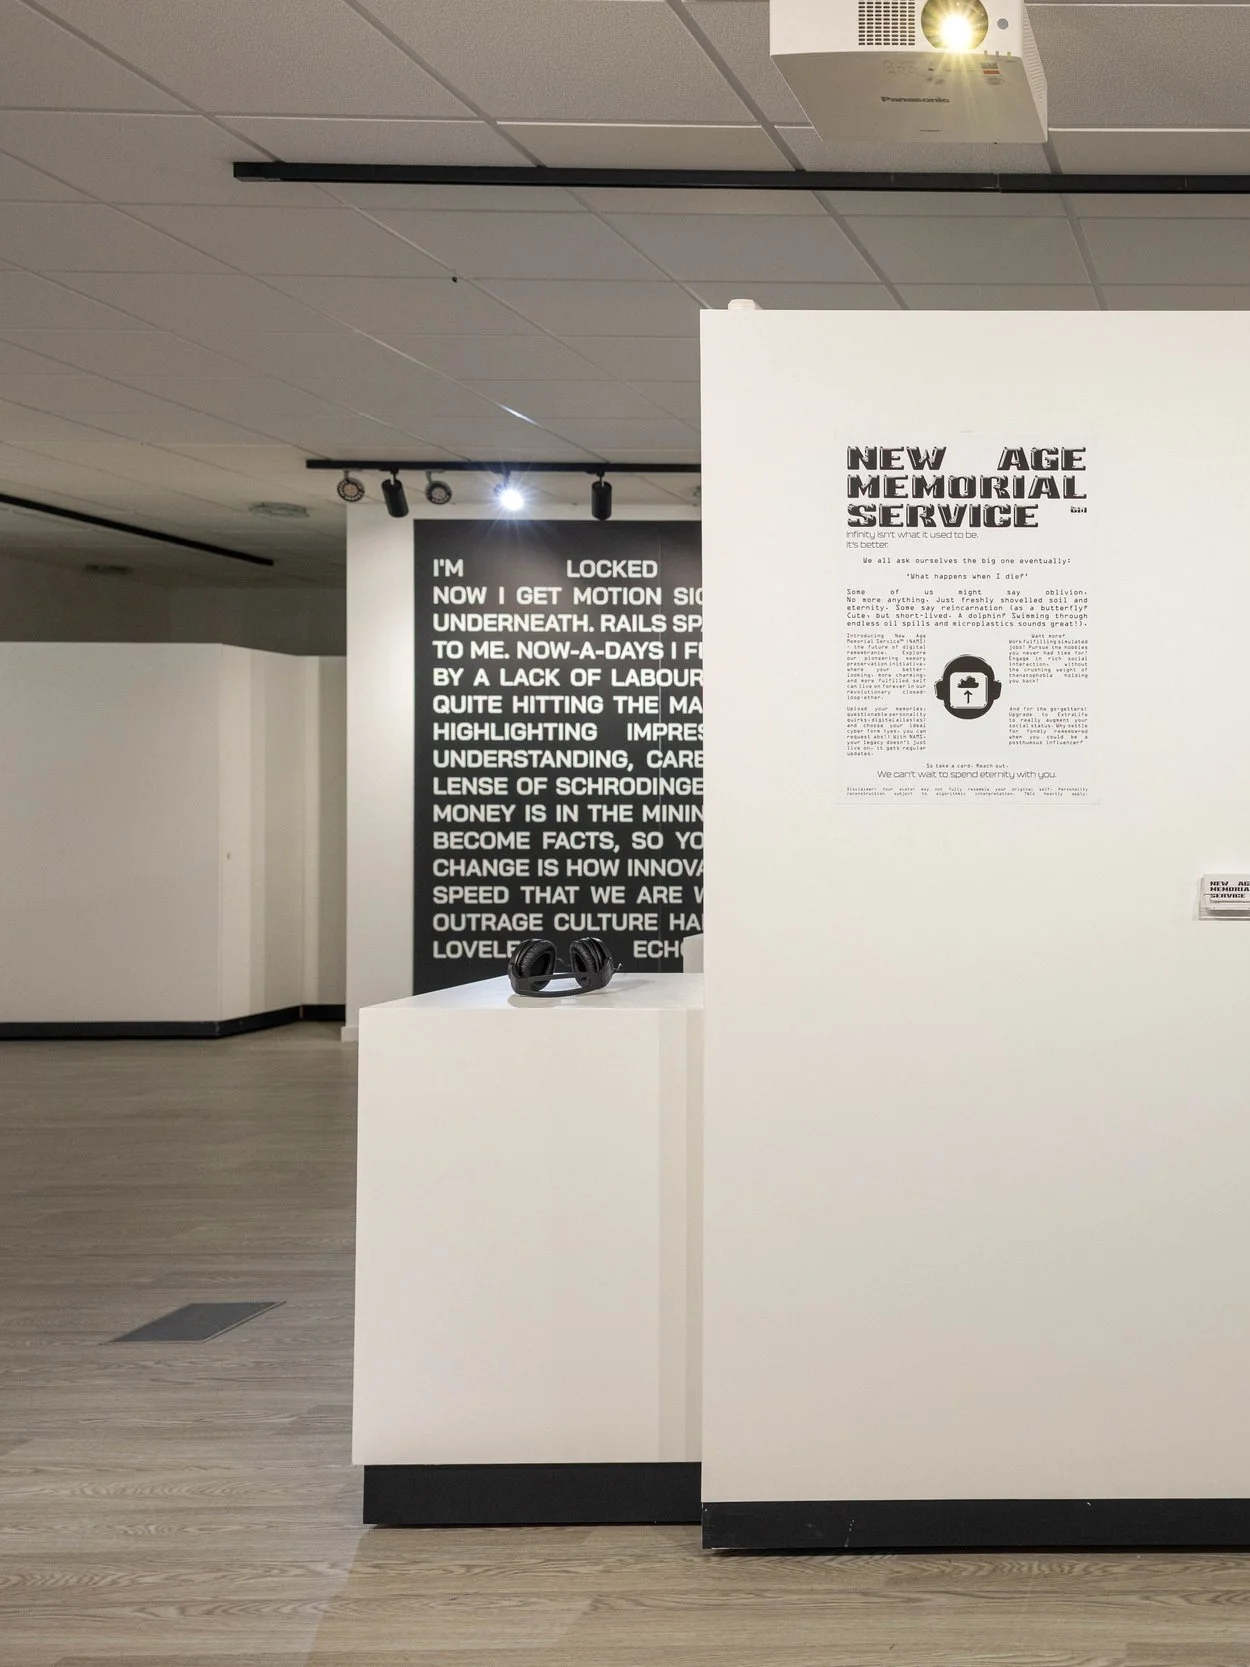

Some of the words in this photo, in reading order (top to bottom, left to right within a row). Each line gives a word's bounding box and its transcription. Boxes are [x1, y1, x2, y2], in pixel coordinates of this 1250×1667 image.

[846, 446, 947, 471] NEW
[996, 446, 1086, 472] AGE
[847, 474, 1087, 500] MEMORIAL
[847, 503, 1039, 528] SERVICE
[847, 531, 875, 540] Infinity
[434, 559, 464, 577] I'M
[566, 560, 658, 578] LOCKED
[433, 586, 488, 605] NOW
[498, 586, 505, 605] I
[516, 586, 563, 605] GET
[573, 586, 662, 606] MOTION
[433, 613, 595, 632] UNDERNEATH.
[600, 614, 667, 633] RAILS
[672, 614, 703, 633] SP
[432, 640, 464, 659] TO
[470, 640, 510, 659] ME.
[516, 640, 664, 660] NOW-A-DAYS
[671, 641, 677, 660] I
[433, 668, 464, 686] BY
[473, 668, 490, 686] A
[500, 668, 560, 687] LACK
[570, 668, 602, 687] OF
[611, 668, 703, 687] LABOUR
[433, 695, 503, 714] QUITE
[512, 695, 604, 714] HITTING
[612, 695, 661, 714] THE
[669, 696, 703, 714] MA
[433, 722, 598, 741] HIGHLIGHTING
[433, 750, 634, 772] UNDERSTANDING,
[950, 771, 978, 779] spend
[980, 771, 1015, 779] eternity
[433, 777, 508, 795] LENSE
[516, 777, 548, 795] OF
[556, 777, 703, 796] SCHRODINGE
[434, 804, 516, 822] MONEY
[525, 804, 546, 822] IS
[556, 804, 578, 822] IN
[587, 804, 633, 822] THE
[434, 832, 530, 849] BECOME
[543, 832, 619, 853] FACTS,
[632, 832, 663, 849] SO
[675, 832, 703, 849] YO
[433, 859, 530, 876] CHANGE
[538, 859, 559, 876] IS
[567, 859, 620, 876] HOW
[433, 886, 509, 904] SPEED
[520, 886, 579, 904] THAT
[590, 886, 625, 904] WE
[636, 886, 682, 904] ARE
[433, 913, 543, 931] OUTRAGE
[554, 913, 658, 931] CULTURE
[670, 913, 703, 930] HA
[633, 940, 684, 958] ECH
